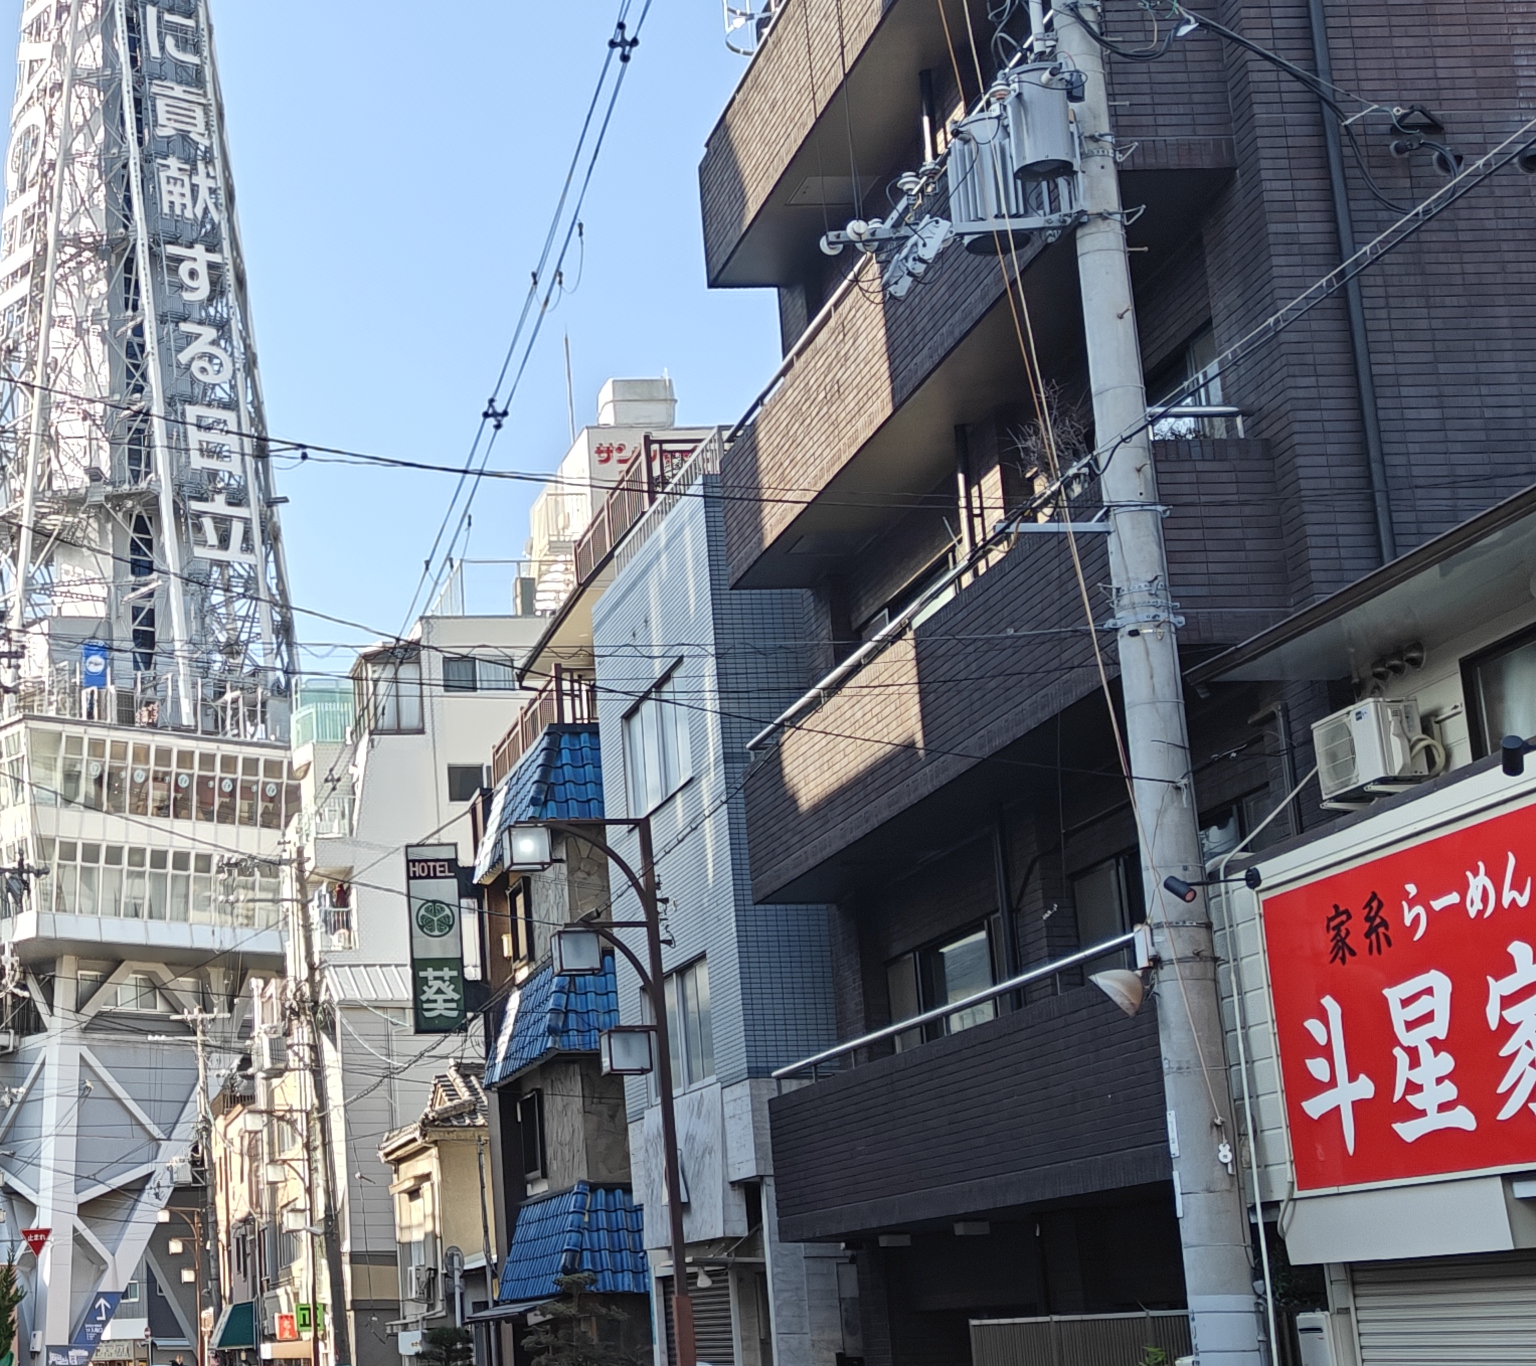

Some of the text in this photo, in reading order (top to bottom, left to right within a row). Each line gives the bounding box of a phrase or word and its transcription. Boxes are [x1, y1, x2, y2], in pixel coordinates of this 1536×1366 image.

[409, 861, 455, 878] HOTEL
[1325, 851, 1531, 966] 家系らーめん
[419, 967, 461, 1018] 葵
[27, 1233, 46, 1242] 止まれ
